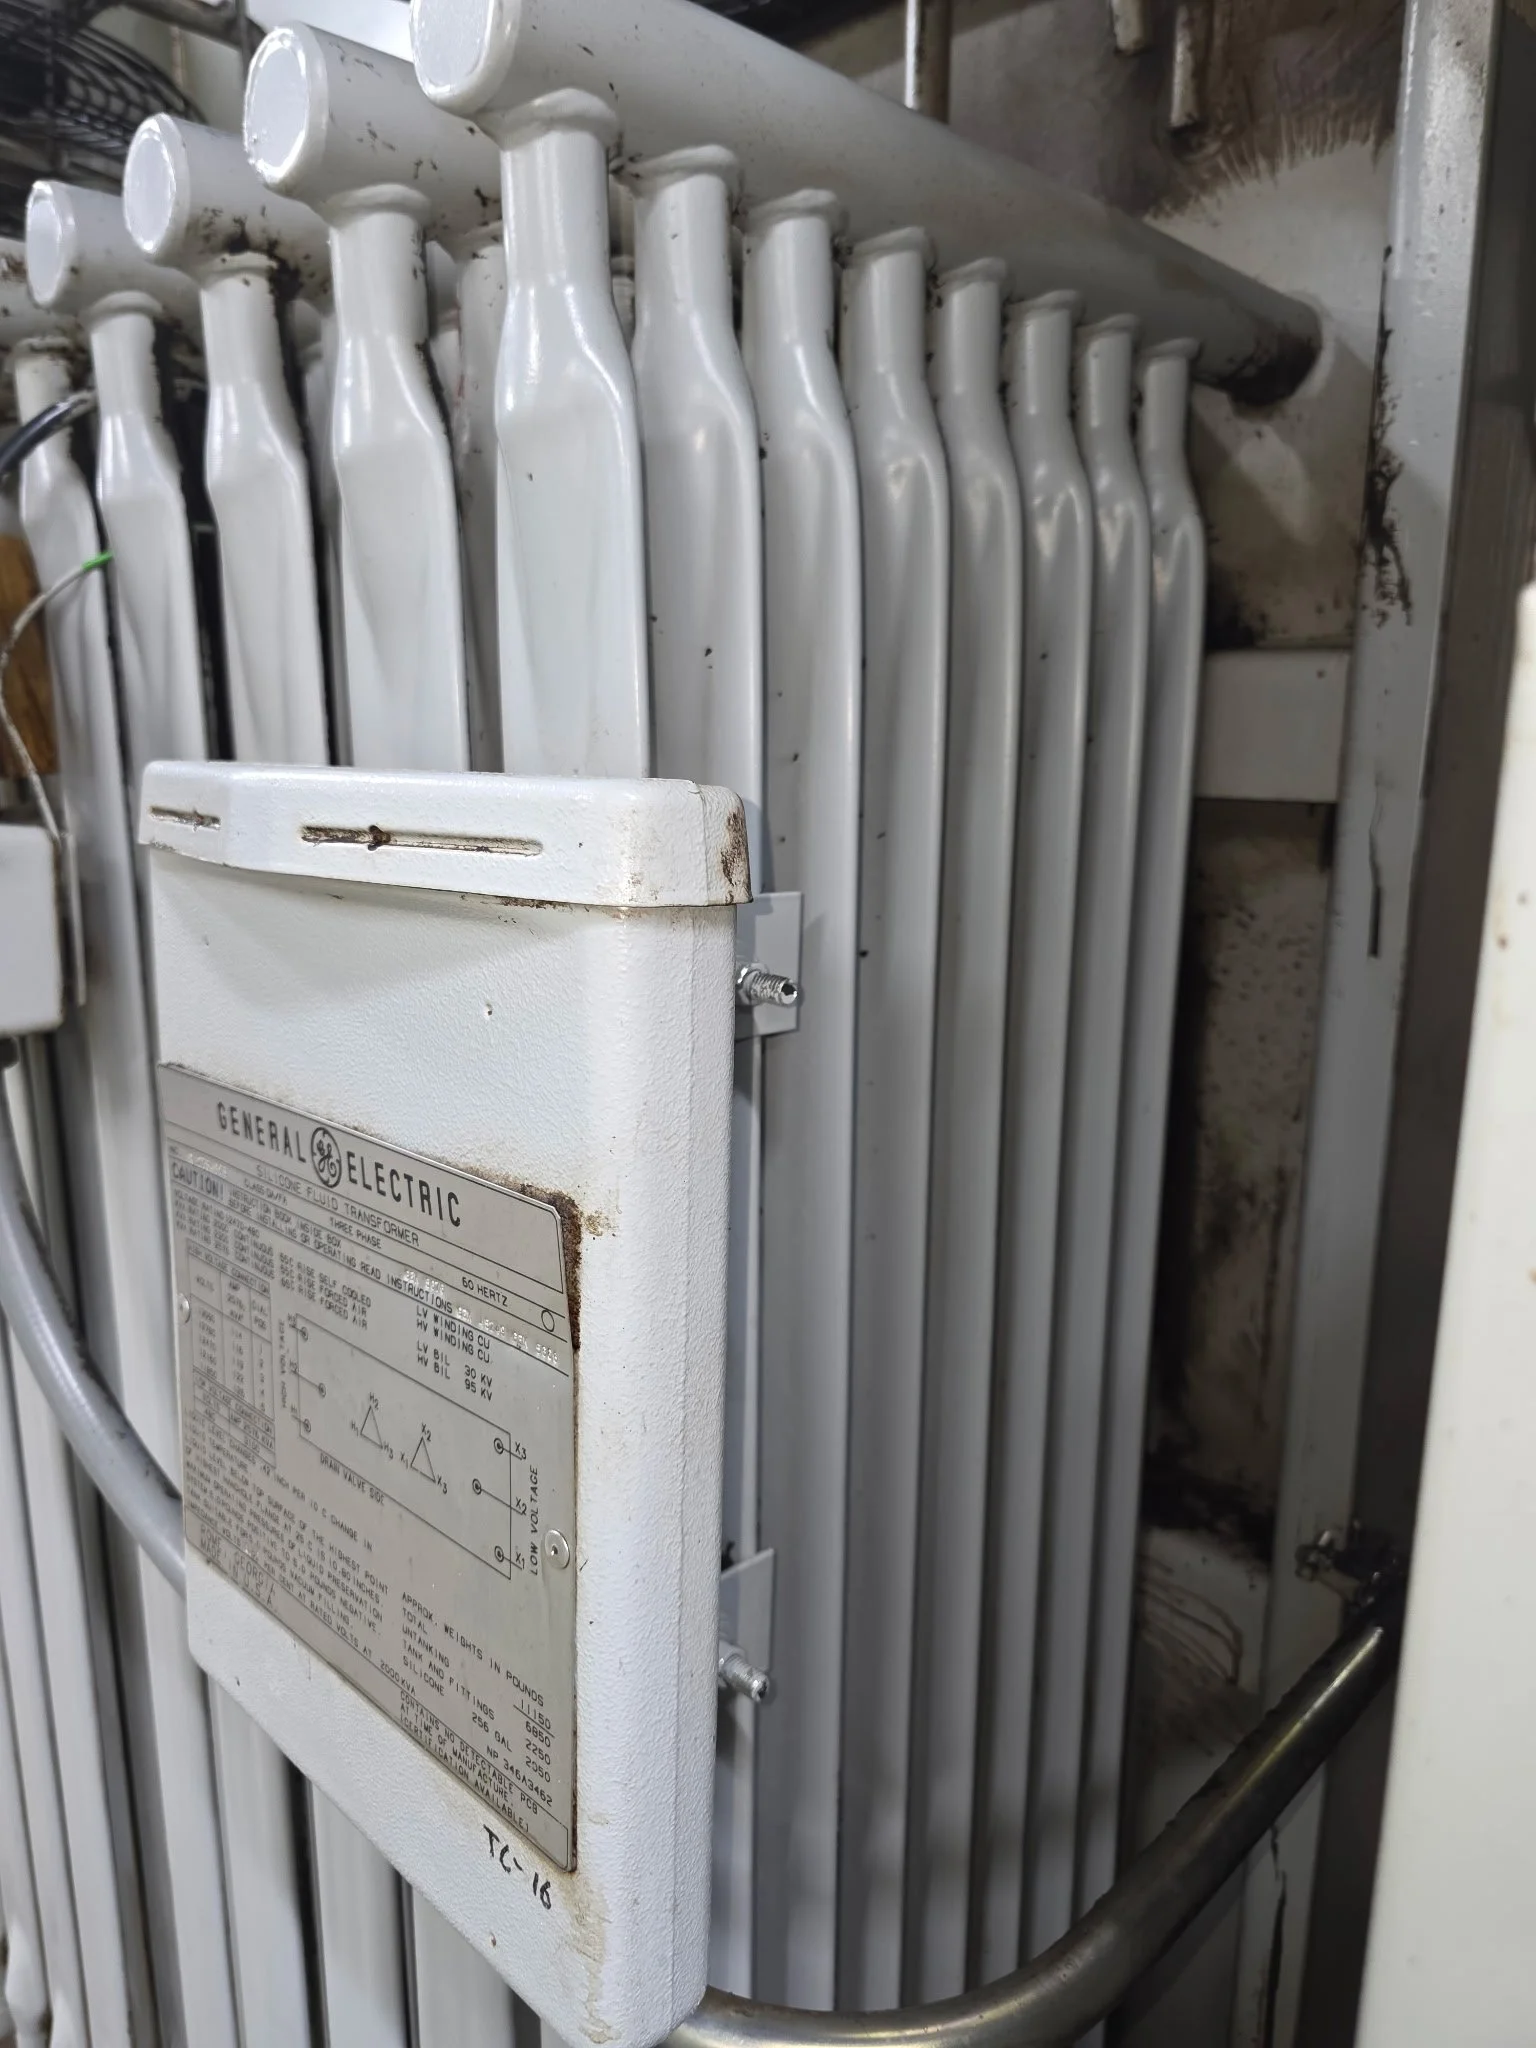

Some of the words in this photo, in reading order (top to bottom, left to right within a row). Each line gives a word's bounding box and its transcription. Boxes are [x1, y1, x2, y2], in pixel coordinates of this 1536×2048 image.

[172, 1161, 223, 1200] CAUTION!
[217, 1100, 306, 1164] GENERAL
[346, 1150, 460, 1228] ELECTRIC
[255, 1164, 301, 1194] SILICONE
[307, 1186, 338, 1210] FLUID
[344, 1202, 419, 1247] TRANSFORMER
[297, 1220, 322, 1239] INSIDE
[326, 1233, 341, 1249] BOX
[330, 1217, 352, 1236] THREE
[356, 1228, 381, 1249] PHASE
[297, 1261, 314, 1279] RISE
[319, 1272, 337, 1290] SELF
[342, 1284, 371, 1309] COOLED
[297, 1272, 315, 1290] RISE
[319, 1284, 347, 1308] FORCED
[351, 1301, 366, 1318] AIR
[300, 1233, 310, 1245] OR
[314, 1239, 356, 1268] OPERATING
[360, 1261, 381, 1280] READ
[387, 1272, 453, 1315] INSTRUCTIONS
[462, 1276, 473, 1291] 60
[476, 1283, 507, 1307] HERTZ
[298, 1284, 315, 1303] RISE
[319, 1296, 348, 1320] FORCED
[352, 1313, 367, 1330] AIR
[415, 1304, 428, 1320] LV
[433, 1313, 473, 1343] WINDING
[477, 1334, 490, 1351] CU
[416, 1318, 428, 1333] HV
[433, 1326, 473, 1356] WINDING
[477, 1348, 490, 1365] CU
[416, 1340, 428, 1356] LV
[433, 1348, 450, 1367] BIL
[464, 1364, 476, 1381] 30
[480, 1372, 493, 1389] KV
[369, 1392, 379, 1410] H2
[417, 1353, 429, 1369] HV
[433, 1361, 450, 1380] BIL
[464, 1378, 477, 1394] 95
[480, 1386, 493, 1403] KV
[351, 1421, 359, 1437] H1
[421, 1423, 431, 1443] X2
[515, 1441, 526, 1461] X3
[319, 1452, 339, 1476] DRAIN
[343, 1468, 365, 1493] VALVE
[369, 1486, 385, 1506] SIDE
[400, 1452, 408, 1469] X1
[436, 1474, 447, 1495] X3
[515, 1496, 526, 1517] X2
[528, 1463, 539, 1538] VOLTAGE
[283, 1520, 291, 1535] AT
[310, 1498, 318, 1513] 10
[330, 1513, 358, 1543] CHANGE
[363, 1537, 373, 1553] IN
[312, 1529, 324, 1547] THE
[329, 1542, 360, 1575] HIGHEST
[364, 1569, 388, 1597] POINT
[515, 1550, 525, 1570] X1
[529, 1540, 538, 1577] LOW
[290, 1569, 314, 1597] VACUUM
[298, 1547, 323, 1576] LIQUID
[327, 1570, 383, 1624] PRESERVATION
[297, 1589, 306, 1604] AT
[310, 1599, 331, 1626] RATED
[336, 1622, 358, 1649] VOLTS
[362, 1643, 372, 1660] AT
[402, 1606, 427, 1635] TOTAL
[401, 1623, 449, 1669] UNTANKING
[401, 1590, 437, 1626] APPROX.
[444, 1623, 483, 1662] WEIGHTS
[489, 1657, 500, 1675] IN
[505, 1669, 543, 1708] POUNDS
[402, 1654, 445, 1698] SILICONE
[402, 1639, 422, 1663] TANK
[428, 1659, 444, 1681] AND
[449, 1676, 495, 1722] FITTINGS
[471, 1710, 489, 1734] 256
[494, 1729, 512, 1753] GAL
[520, 1699, 551, 1731] 11150
[525, 1719, 551, 1749] 6850
[399, 1711, 468, 1782] (CERTIFICATION
[474, 1776, 529, 1834] AVAILABLE)
[400, 1689, 440, 1732] CONTAINS
[444, 1727, 454, 1744] NO
[459, 1740, 513, 1795] DETECTABLE
[520, 1791, 538, 1816] PCB
[400, 1701, 408, 1716] AT
[414, 1714, 433, 1737] TIME
[437, 1733, 447, 1750] OF
[452, 1745, 513, 1808] MANUFACTURE.
[525, 1737, 551, 1767] 2250
[485, 1743, 499, 1764] NP
[503, 1758, 553, 1808] 346A3462
